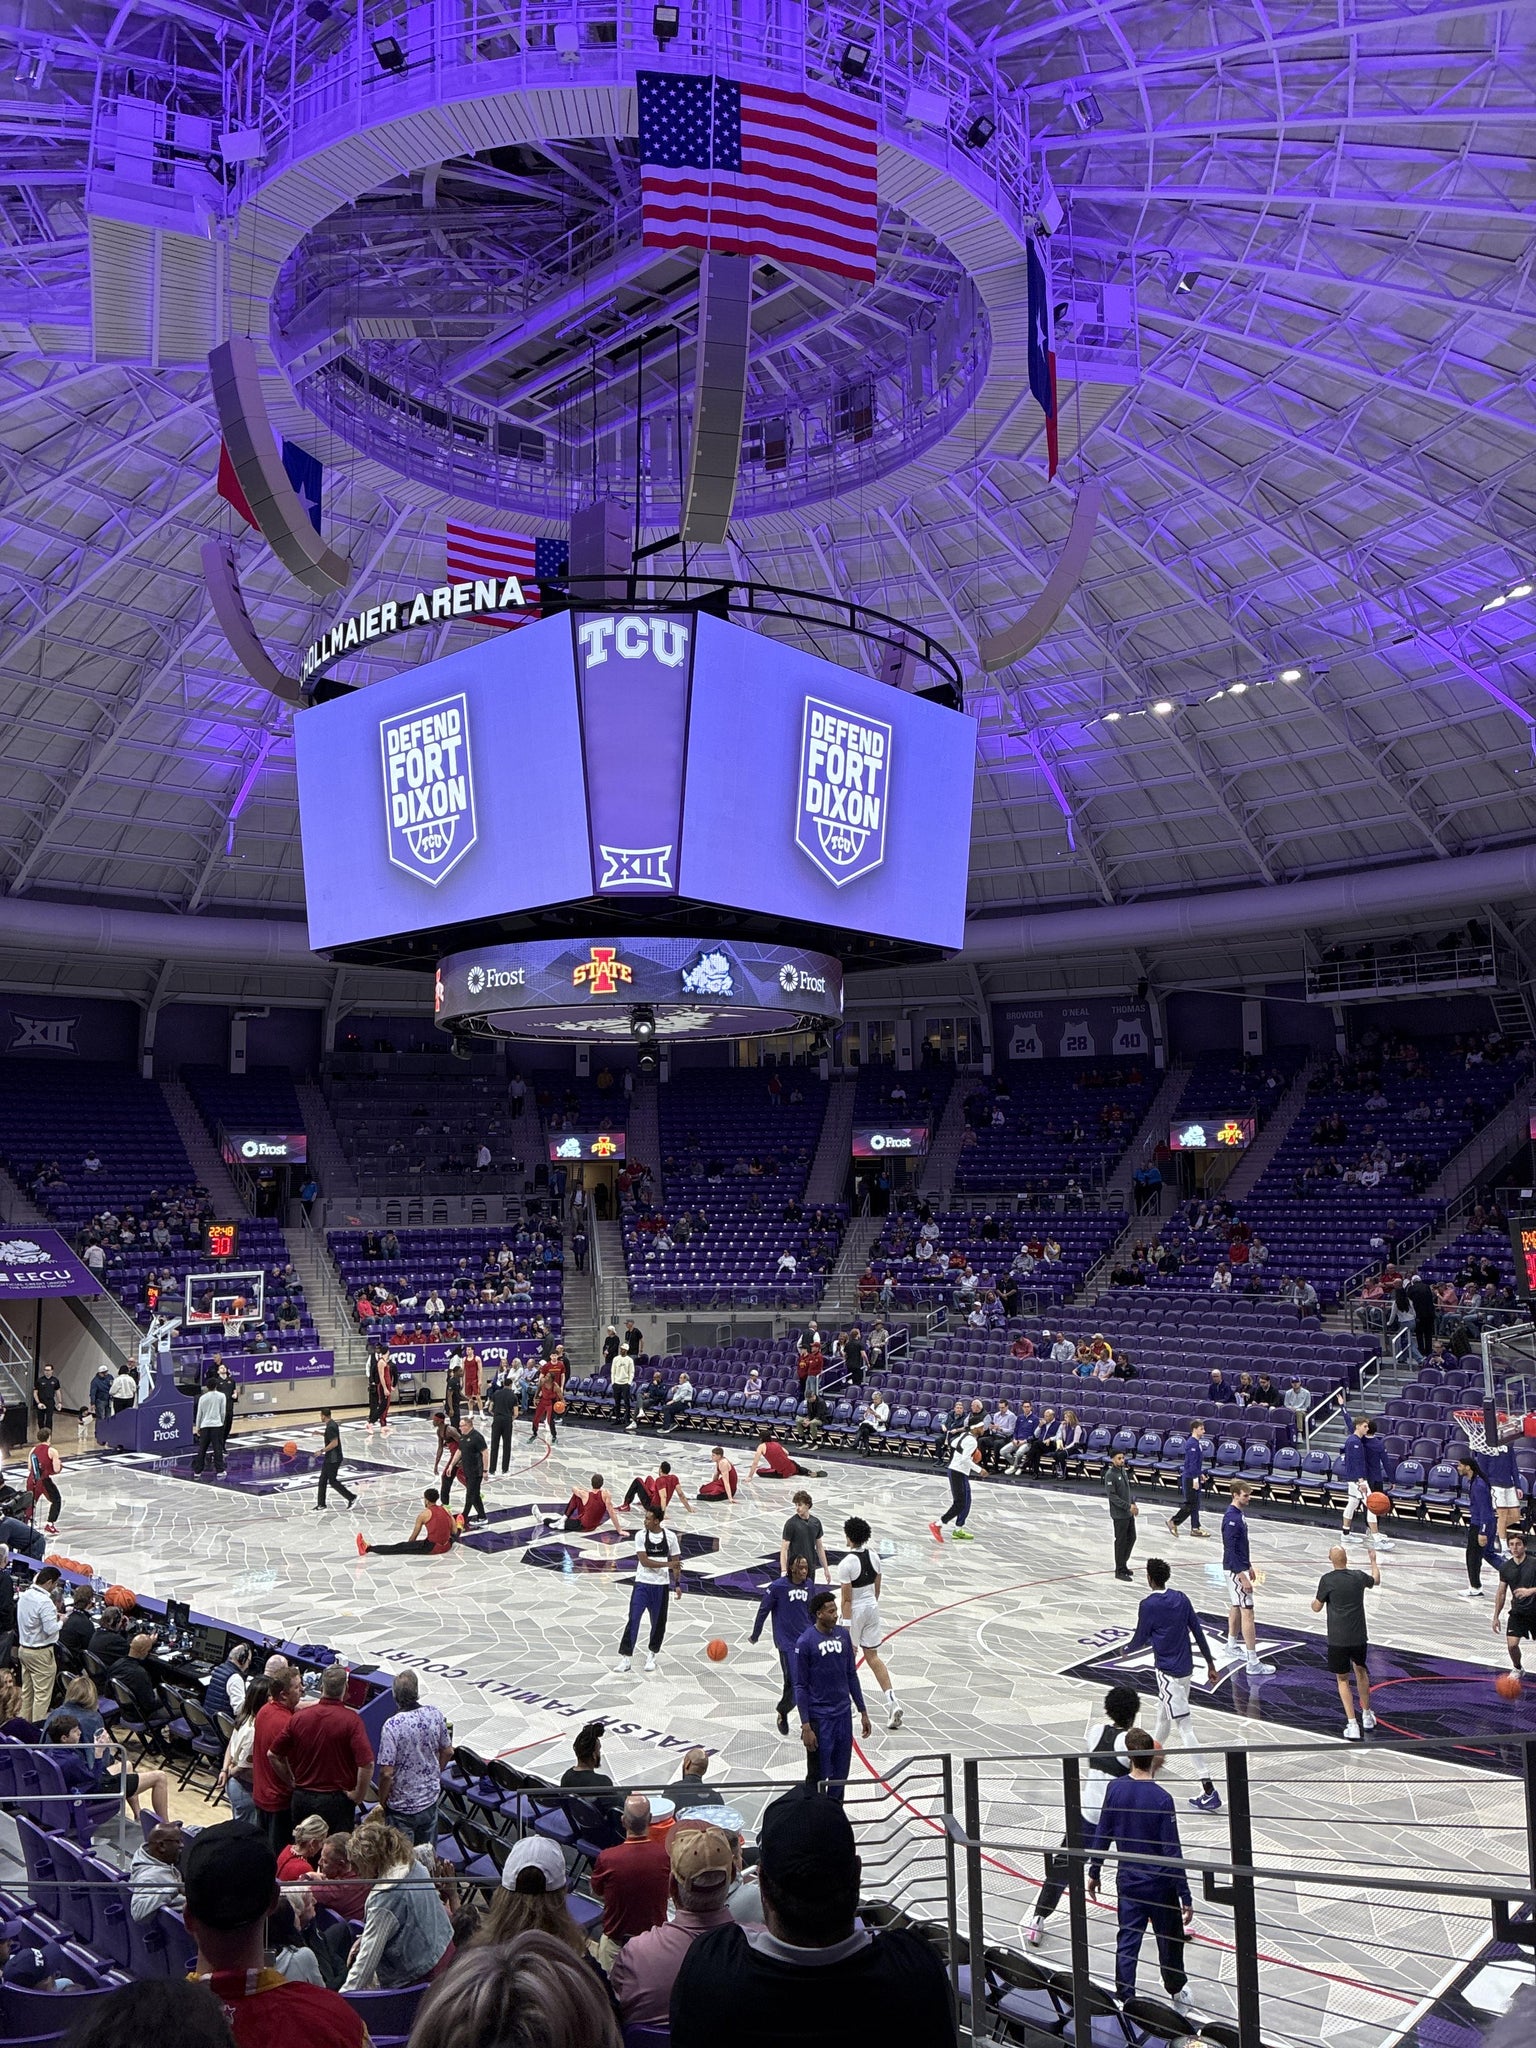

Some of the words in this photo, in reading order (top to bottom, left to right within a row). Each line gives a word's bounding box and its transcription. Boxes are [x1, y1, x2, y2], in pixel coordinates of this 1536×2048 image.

[409, 575, 526, 625] ARENA
[578, 616, 689, 669] TCU
[387, 708, 461, 756] DEFEND
[811, 710, 885, 759] DEFEND
[388, 735, 462, 794] FORT
[808, 737, 883, 795] FORT
[391, 775, 467, 828] DIXON
[805, 777, 881, 830] DIXON
[421, 834, 442, 852] TCU
[831, 835, 851, 853] TCU
[602, 847, 670, 886] XII
[486, 967, 525, 988] Frost
[572, 961, 633, 987] STATE
[800, 970, 826, 993] Frost
[1006, 1010, 1044, 1020] BROWDER
[1062, 1008, 1090, 1017] O'NEAL
[1111, 1004, 1146, 1014] THOMAS
[12, 1016, 76, 1050] XII
[1119, 1033, 1141, 1048] 40
[1015, 1038, 1036, 1053] 24
[1066, 1036, 1088, 1051] 28
[258, 1143, 287, 1155] Frost
[885, 1136, 912, 1148] Frost
[208, 1226, 234, 1237] 22:48
[210, 1237, 231, 1256] 30
[13, 1269, 71, 1282] EECU
[391, 1352, 417, 1365] TCU
[481, 1347, 509, 1362] TCU
[254, 1360, 284, 1376] TCU
[153, 1429, 180, 1442] Frost
[1224, 1442, 1237, 1450] TCU
[1252, 1445, 1265, 1453] TCU
[1281, 1448, 1294, 1456] TCU
[1311, 1451, 1325, 1459] TCU
[1403, 1462, 1418, 1470] TCU
[788, 1589, 808, 1602] TCU
[818, 1640, 843, 1656] TCU
[369, 1648, 468, 1679] COURT
[467, 1679, 586, 1717] FAMILY
